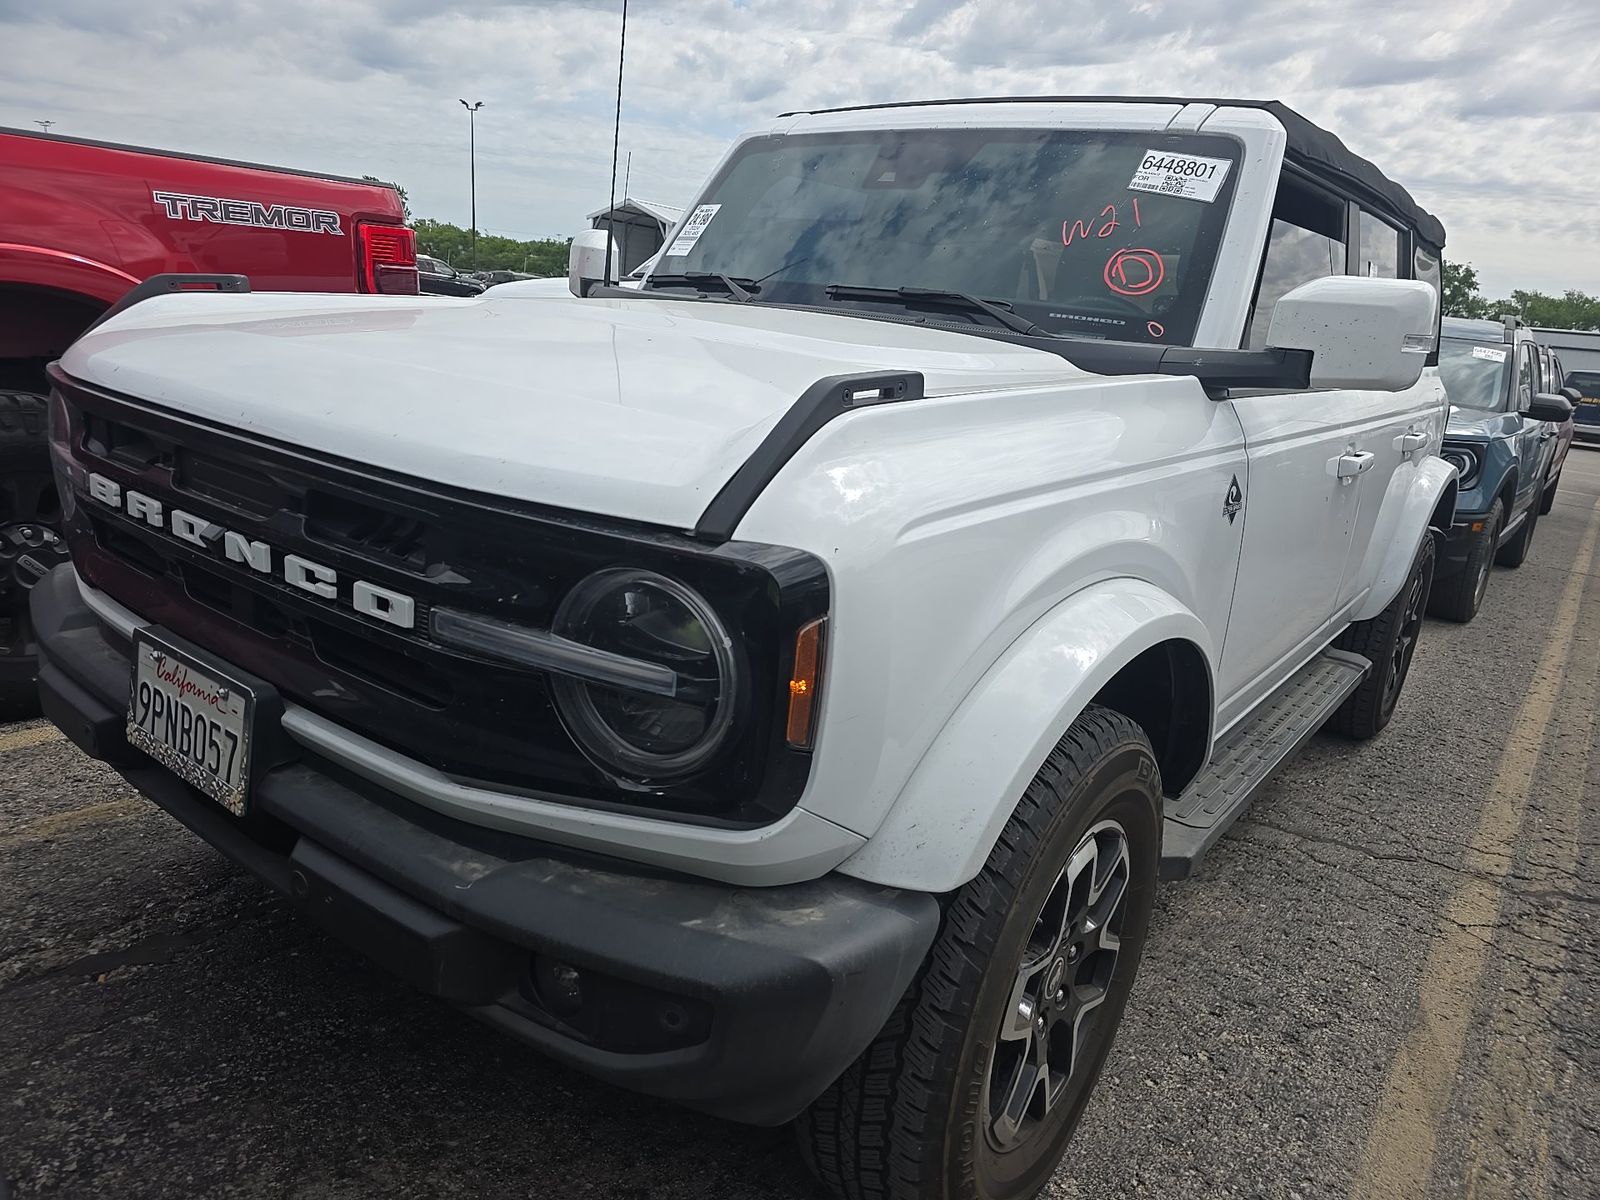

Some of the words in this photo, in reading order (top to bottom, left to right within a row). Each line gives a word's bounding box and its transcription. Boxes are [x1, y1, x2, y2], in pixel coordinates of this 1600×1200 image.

[1142, 155, 1217, 180] 6448801
[153, 190, 345, 236] TREMOR
[1048, 311, 1127, 326] BRONCO
[89, 471, 415, 629] BRONCO
[155, 655, 228, 715] California
[138, 681, 238, 784] 9PNB057
